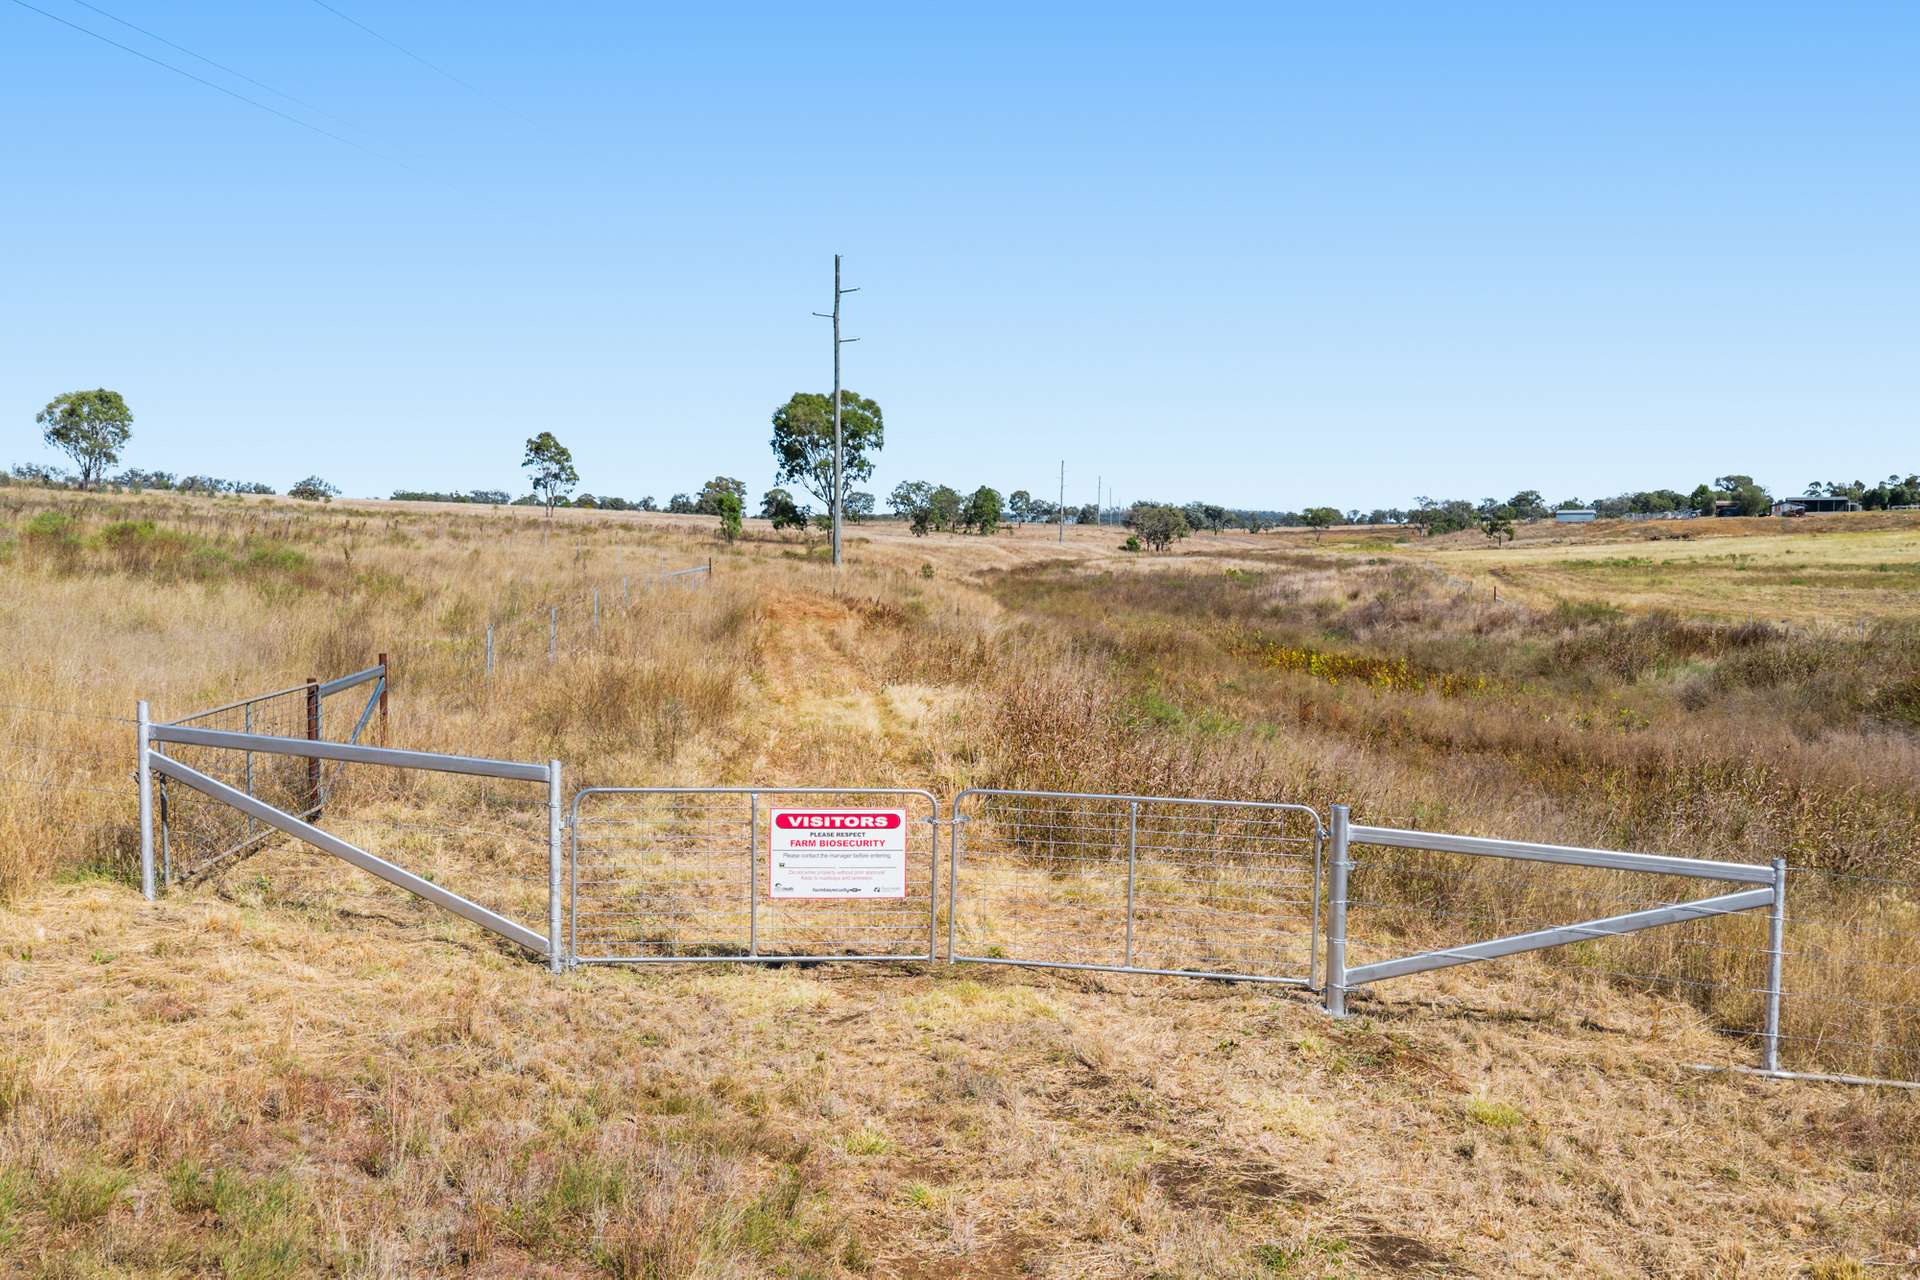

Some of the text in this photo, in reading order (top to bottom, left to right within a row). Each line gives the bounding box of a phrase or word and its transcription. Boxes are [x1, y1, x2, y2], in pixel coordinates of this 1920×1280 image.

[787, 816, 888, 827] VISITORS
[790, 839, 886, 847] FARM BIOSECURITY
